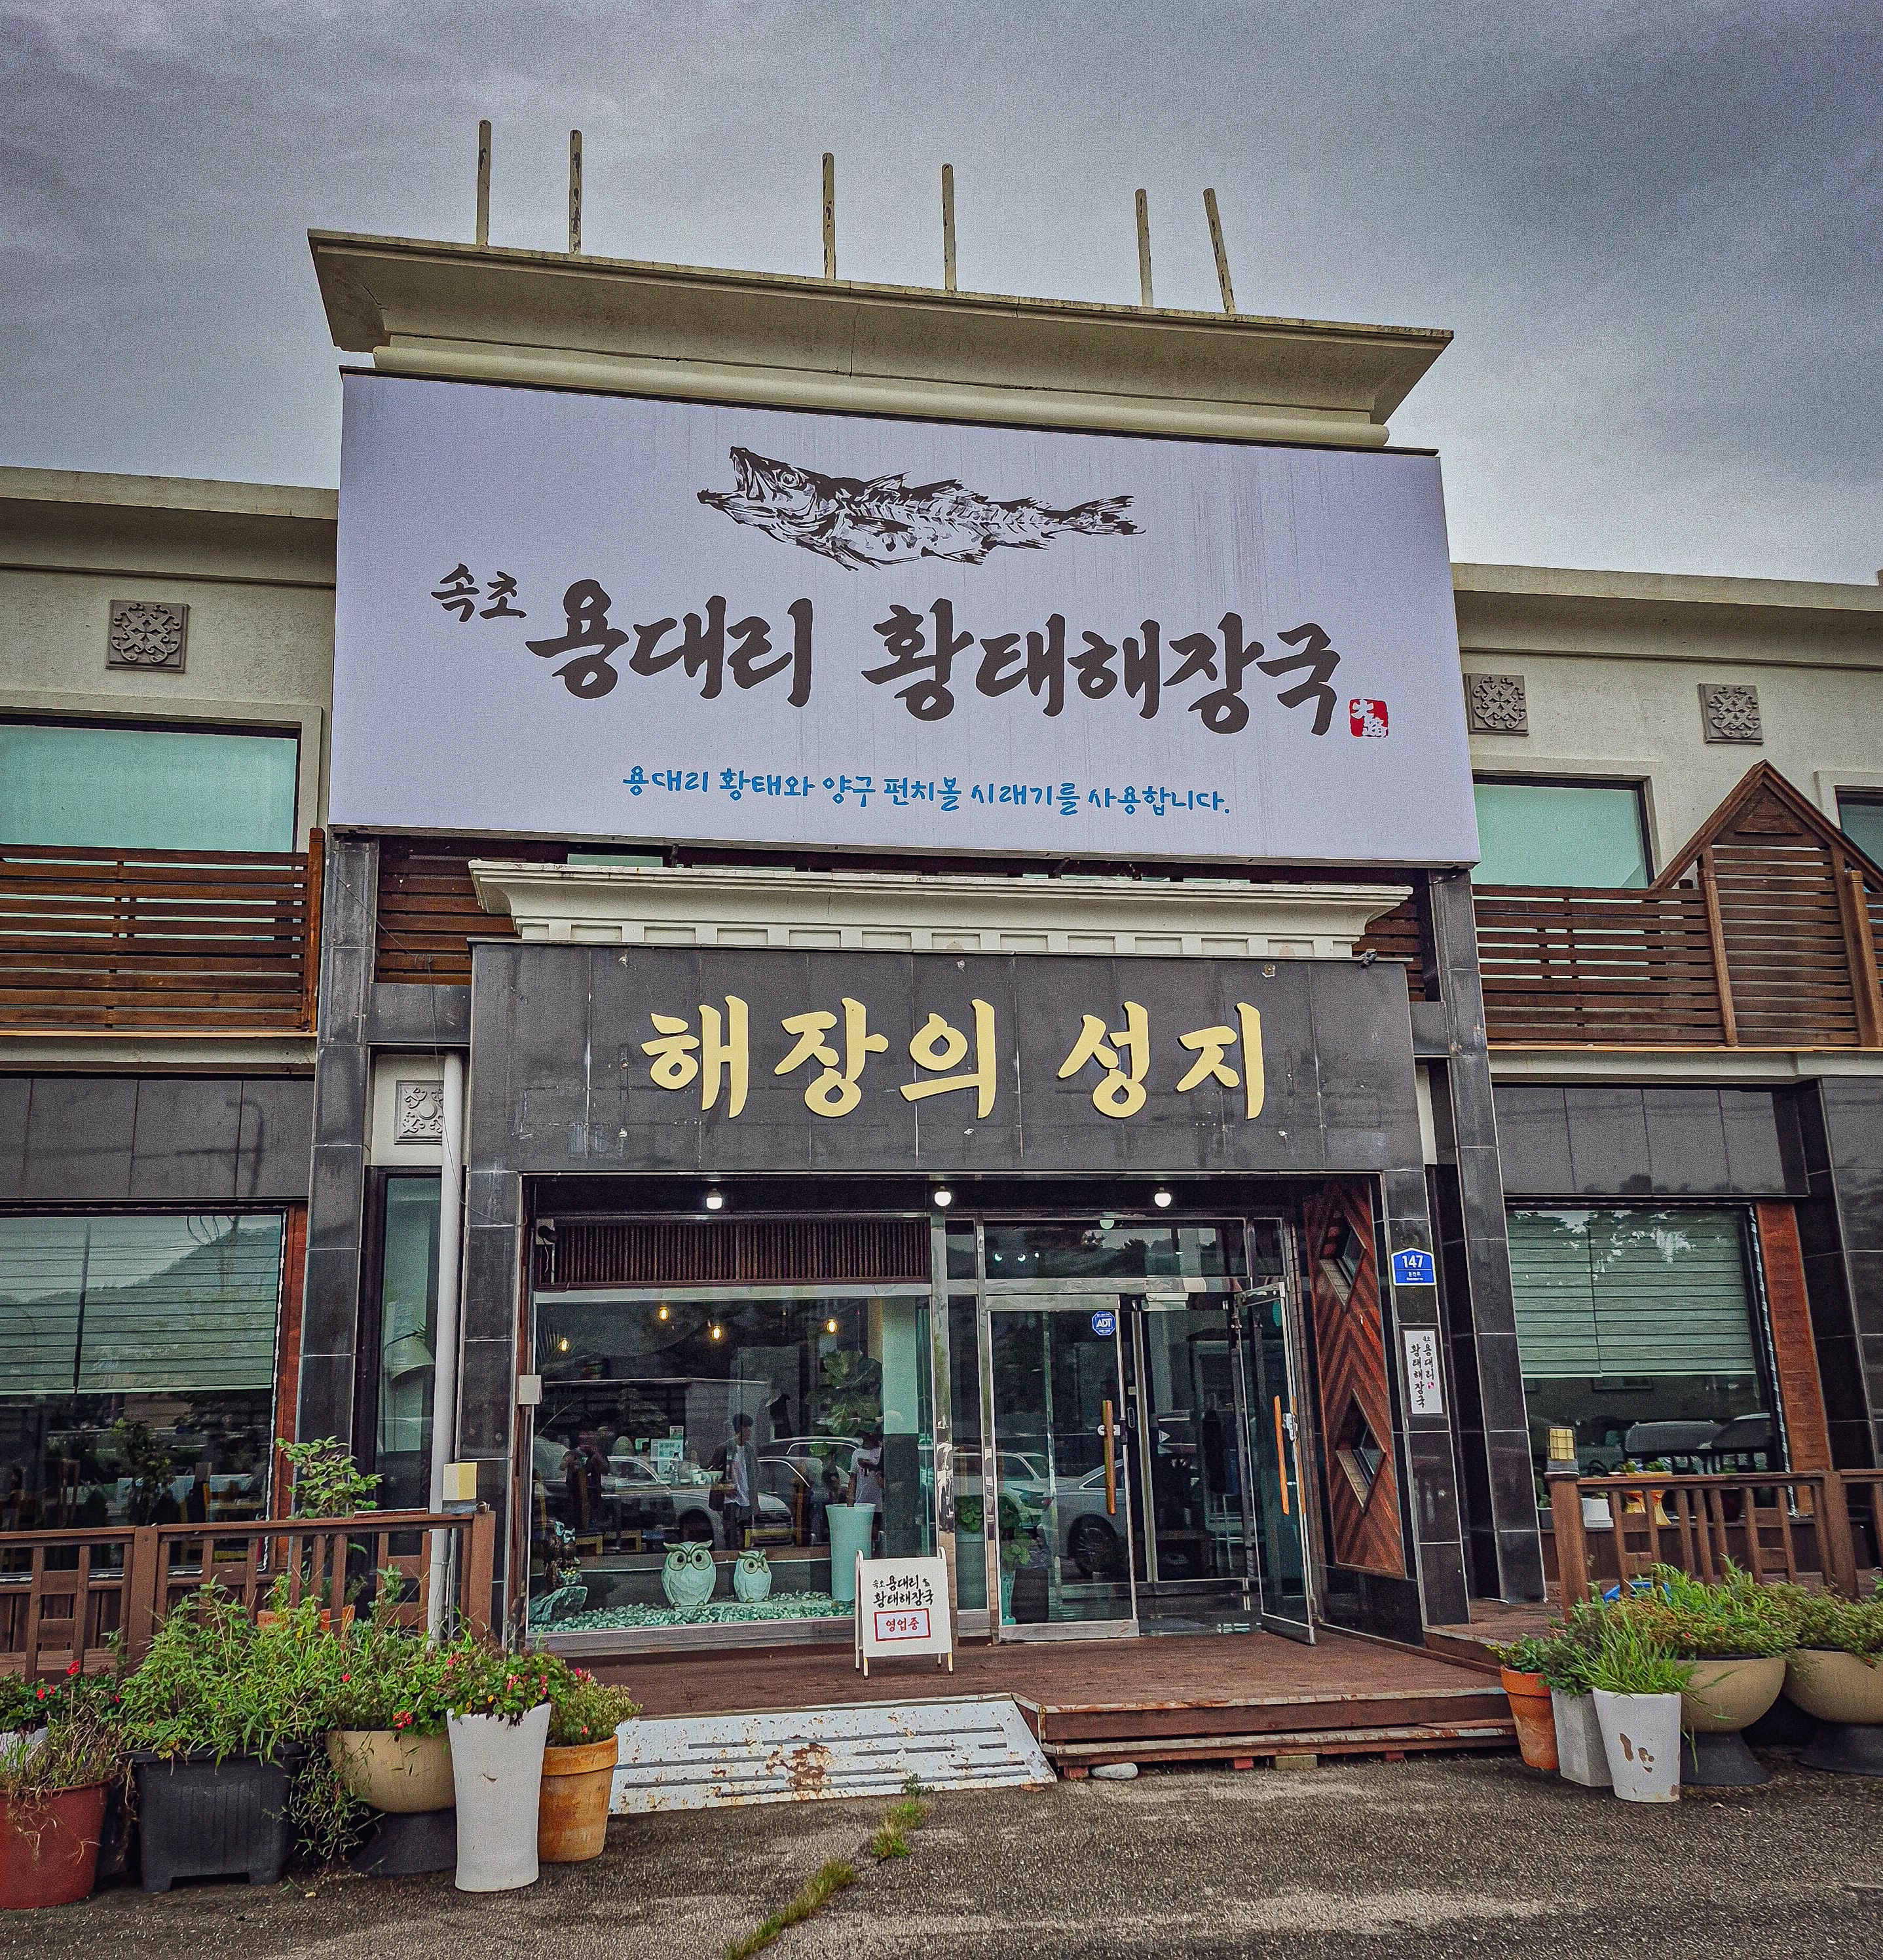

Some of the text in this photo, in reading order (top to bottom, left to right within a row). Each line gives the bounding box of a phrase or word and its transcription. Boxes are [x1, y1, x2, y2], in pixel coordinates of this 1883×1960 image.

[430, 563, 1341, 736] 속초 용대리 황태해장국
[623, 765, 1230, 817] 용대리 황태와 양구 펀치볼 시래기를 사용합니다.
[641, 995, 1265, 1119] 해장의 성지
[1402, 1254, 1423, 1268] 147
[1096, 1318, 1112, 1328] ADT
[1410, 1343, 1425, 1408] 황태해장국
[1423, 1343, 1434, 1380] 용대리
[886, 1574, 919, 1591] 용대리
[872, 1588, 935, 1608] 황태해장국
[886, 1617, 920, 1632] 영업중
